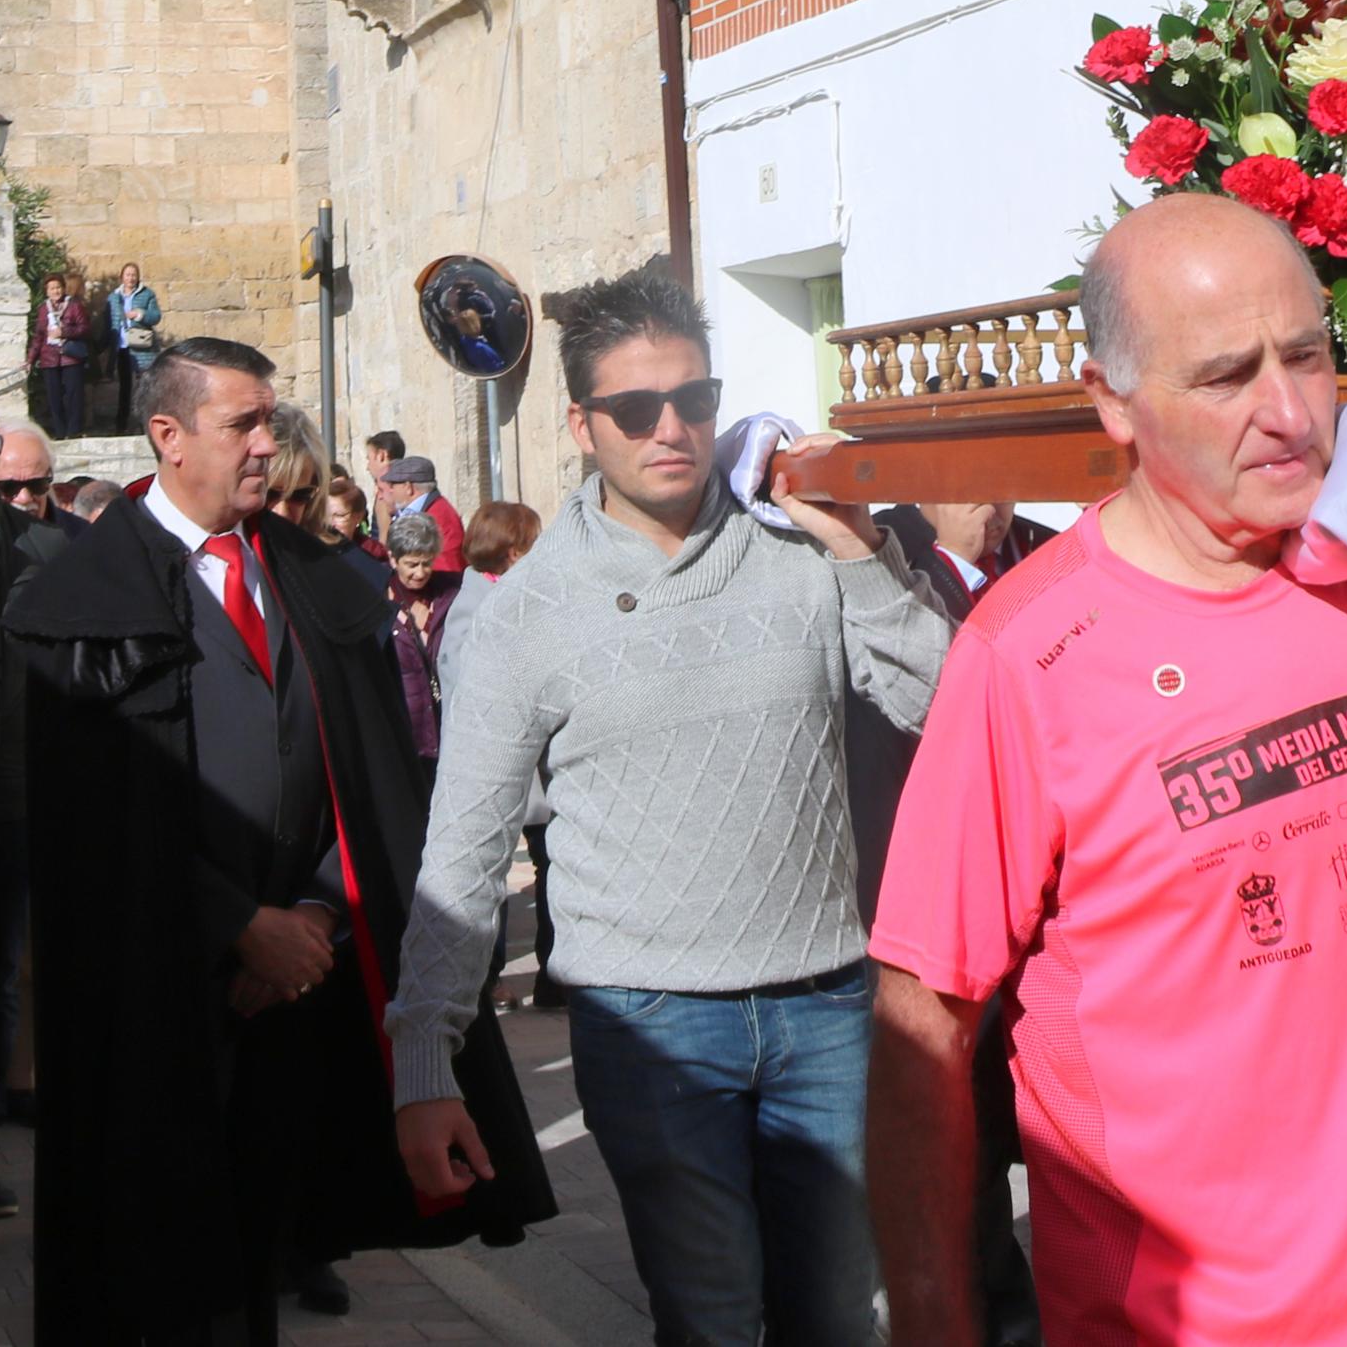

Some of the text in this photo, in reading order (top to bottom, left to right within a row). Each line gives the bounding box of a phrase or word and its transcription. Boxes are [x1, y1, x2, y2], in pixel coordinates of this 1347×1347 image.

[1036, 621, 1087, 670] luanvi
[1256, 719, 1339, 773] MEDIA
[1295, 759, 1331, 787] DEL
